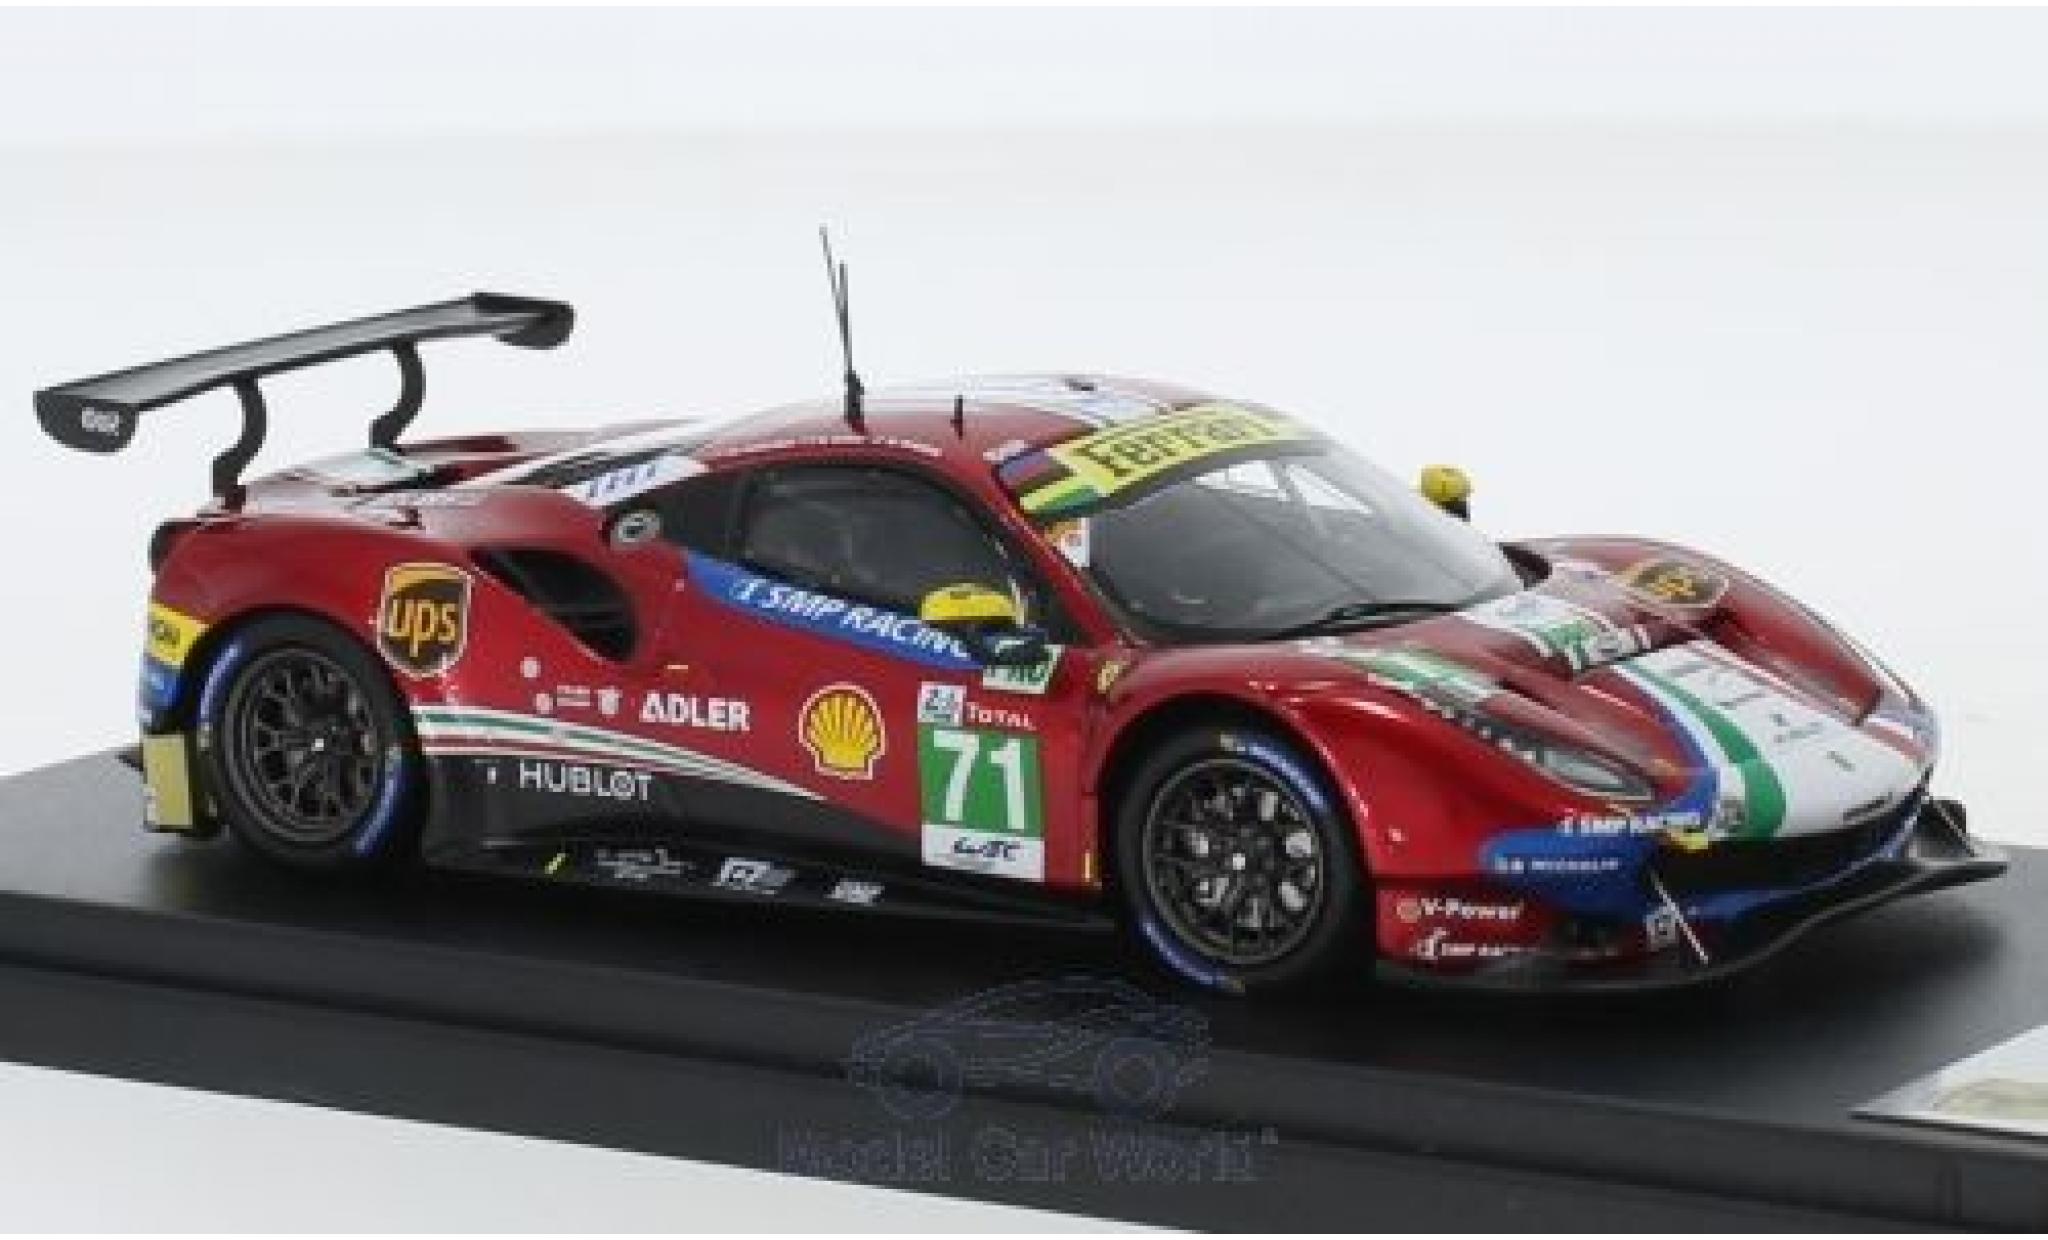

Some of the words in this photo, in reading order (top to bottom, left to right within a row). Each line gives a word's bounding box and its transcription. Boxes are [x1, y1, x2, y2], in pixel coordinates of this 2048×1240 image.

[1070, 415, 1279, 479] Ferrari
[385, 598, 457, 657] ups
[640, 691, 751, 732] ADLER
[967, 701, 1037, 731] TOTAL
[519, 761, 653, 803] HUBLOT
[932, 729, 1027, 830] 71
[1420, 897, 1524, 922] V-Power
